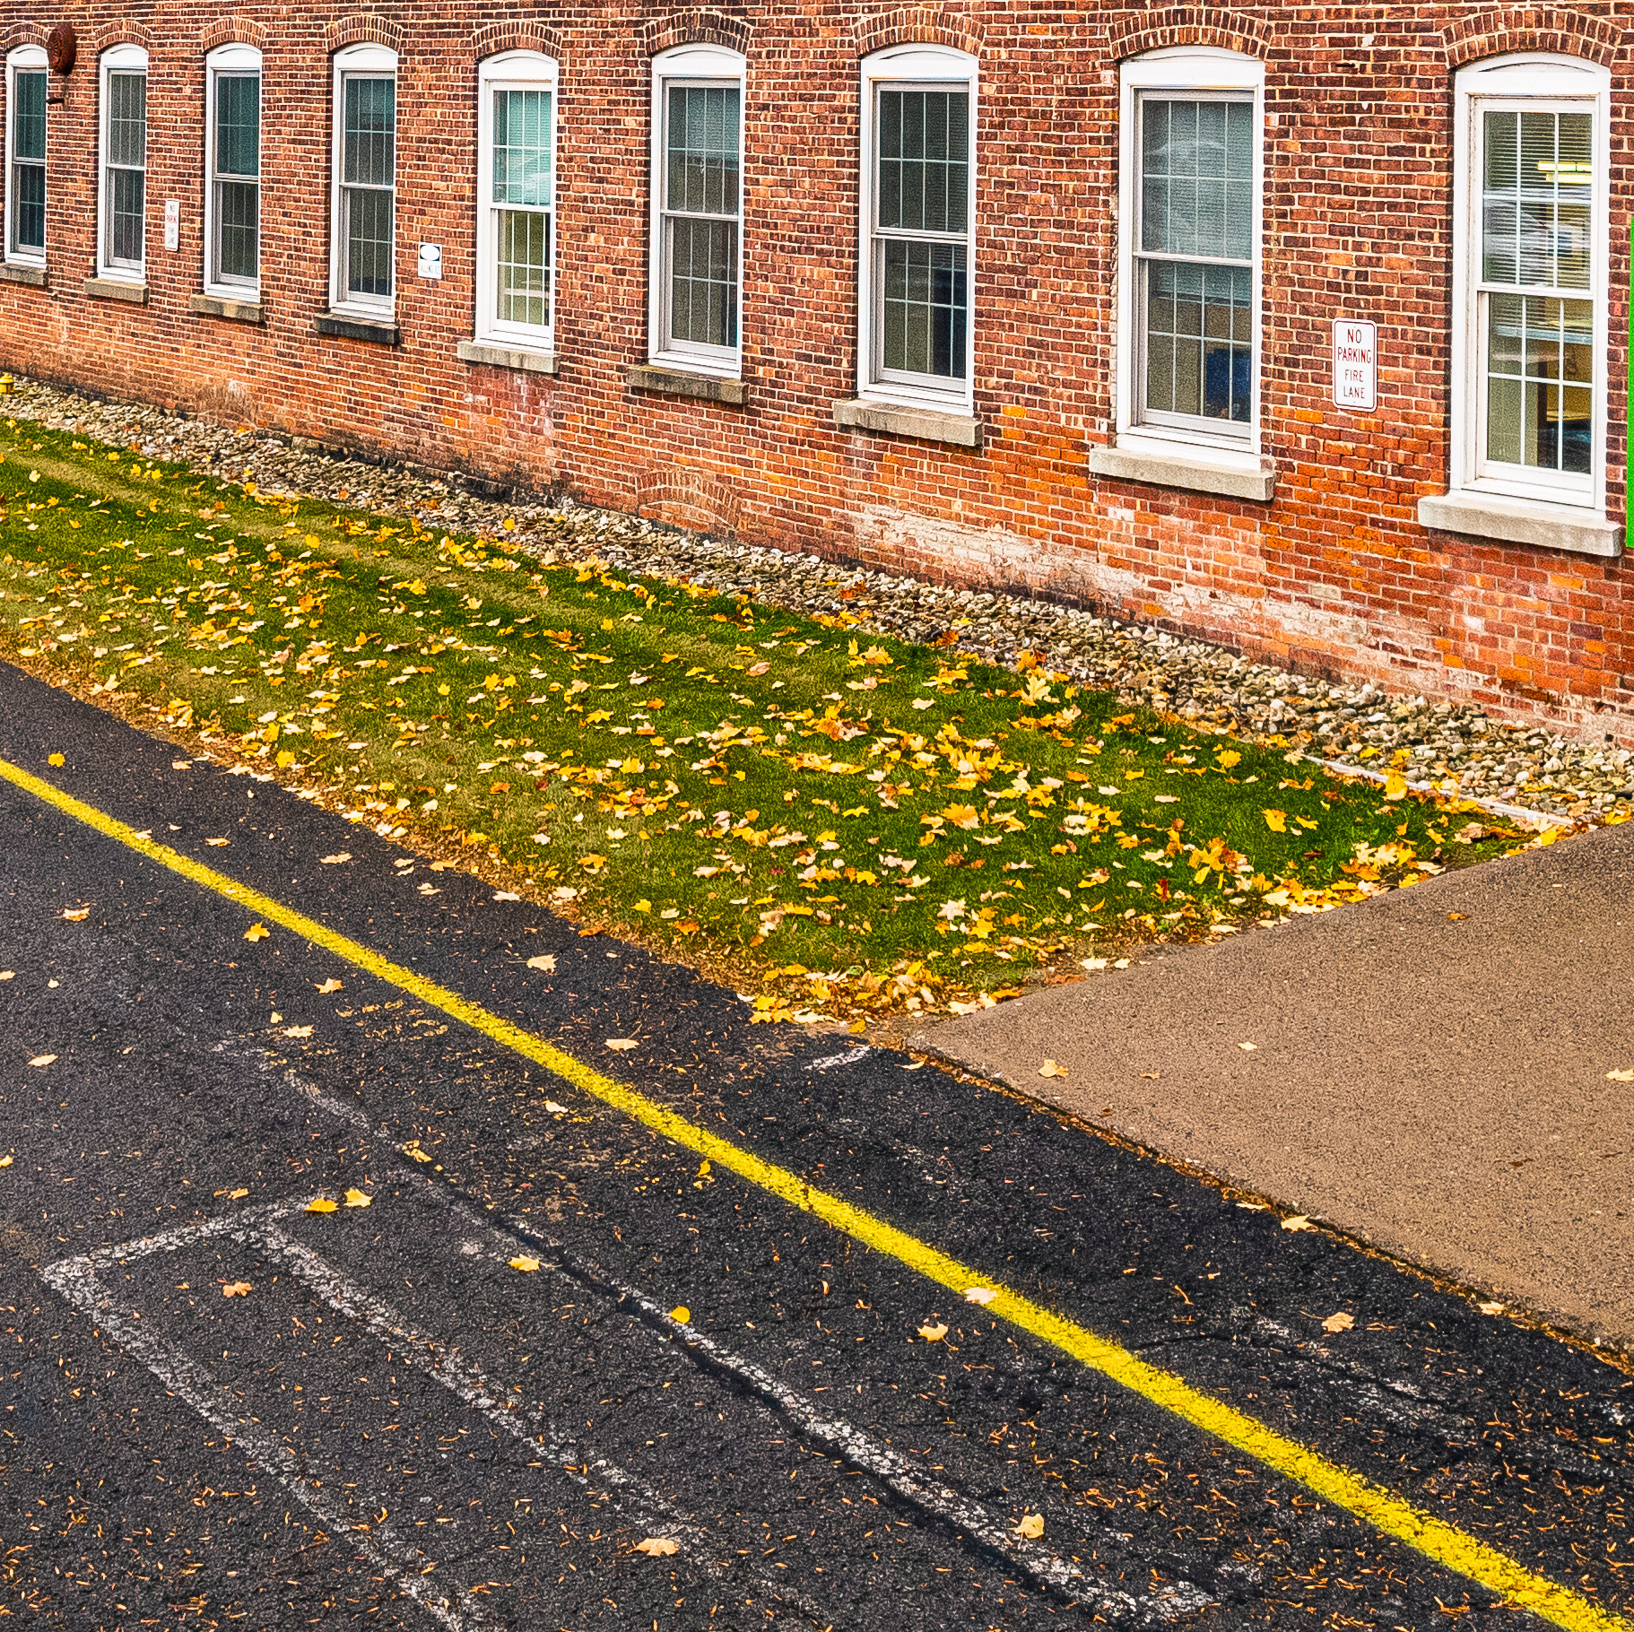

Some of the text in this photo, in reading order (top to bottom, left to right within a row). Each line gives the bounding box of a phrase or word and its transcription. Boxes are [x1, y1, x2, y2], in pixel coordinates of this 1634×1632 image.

[1347, 329, 1362, 343] NO
[1337, 347, 1371, 363] PARKING
[1344, 369, 1364, 382] FIRE
[1343, 386, 1366, 399] LANE
